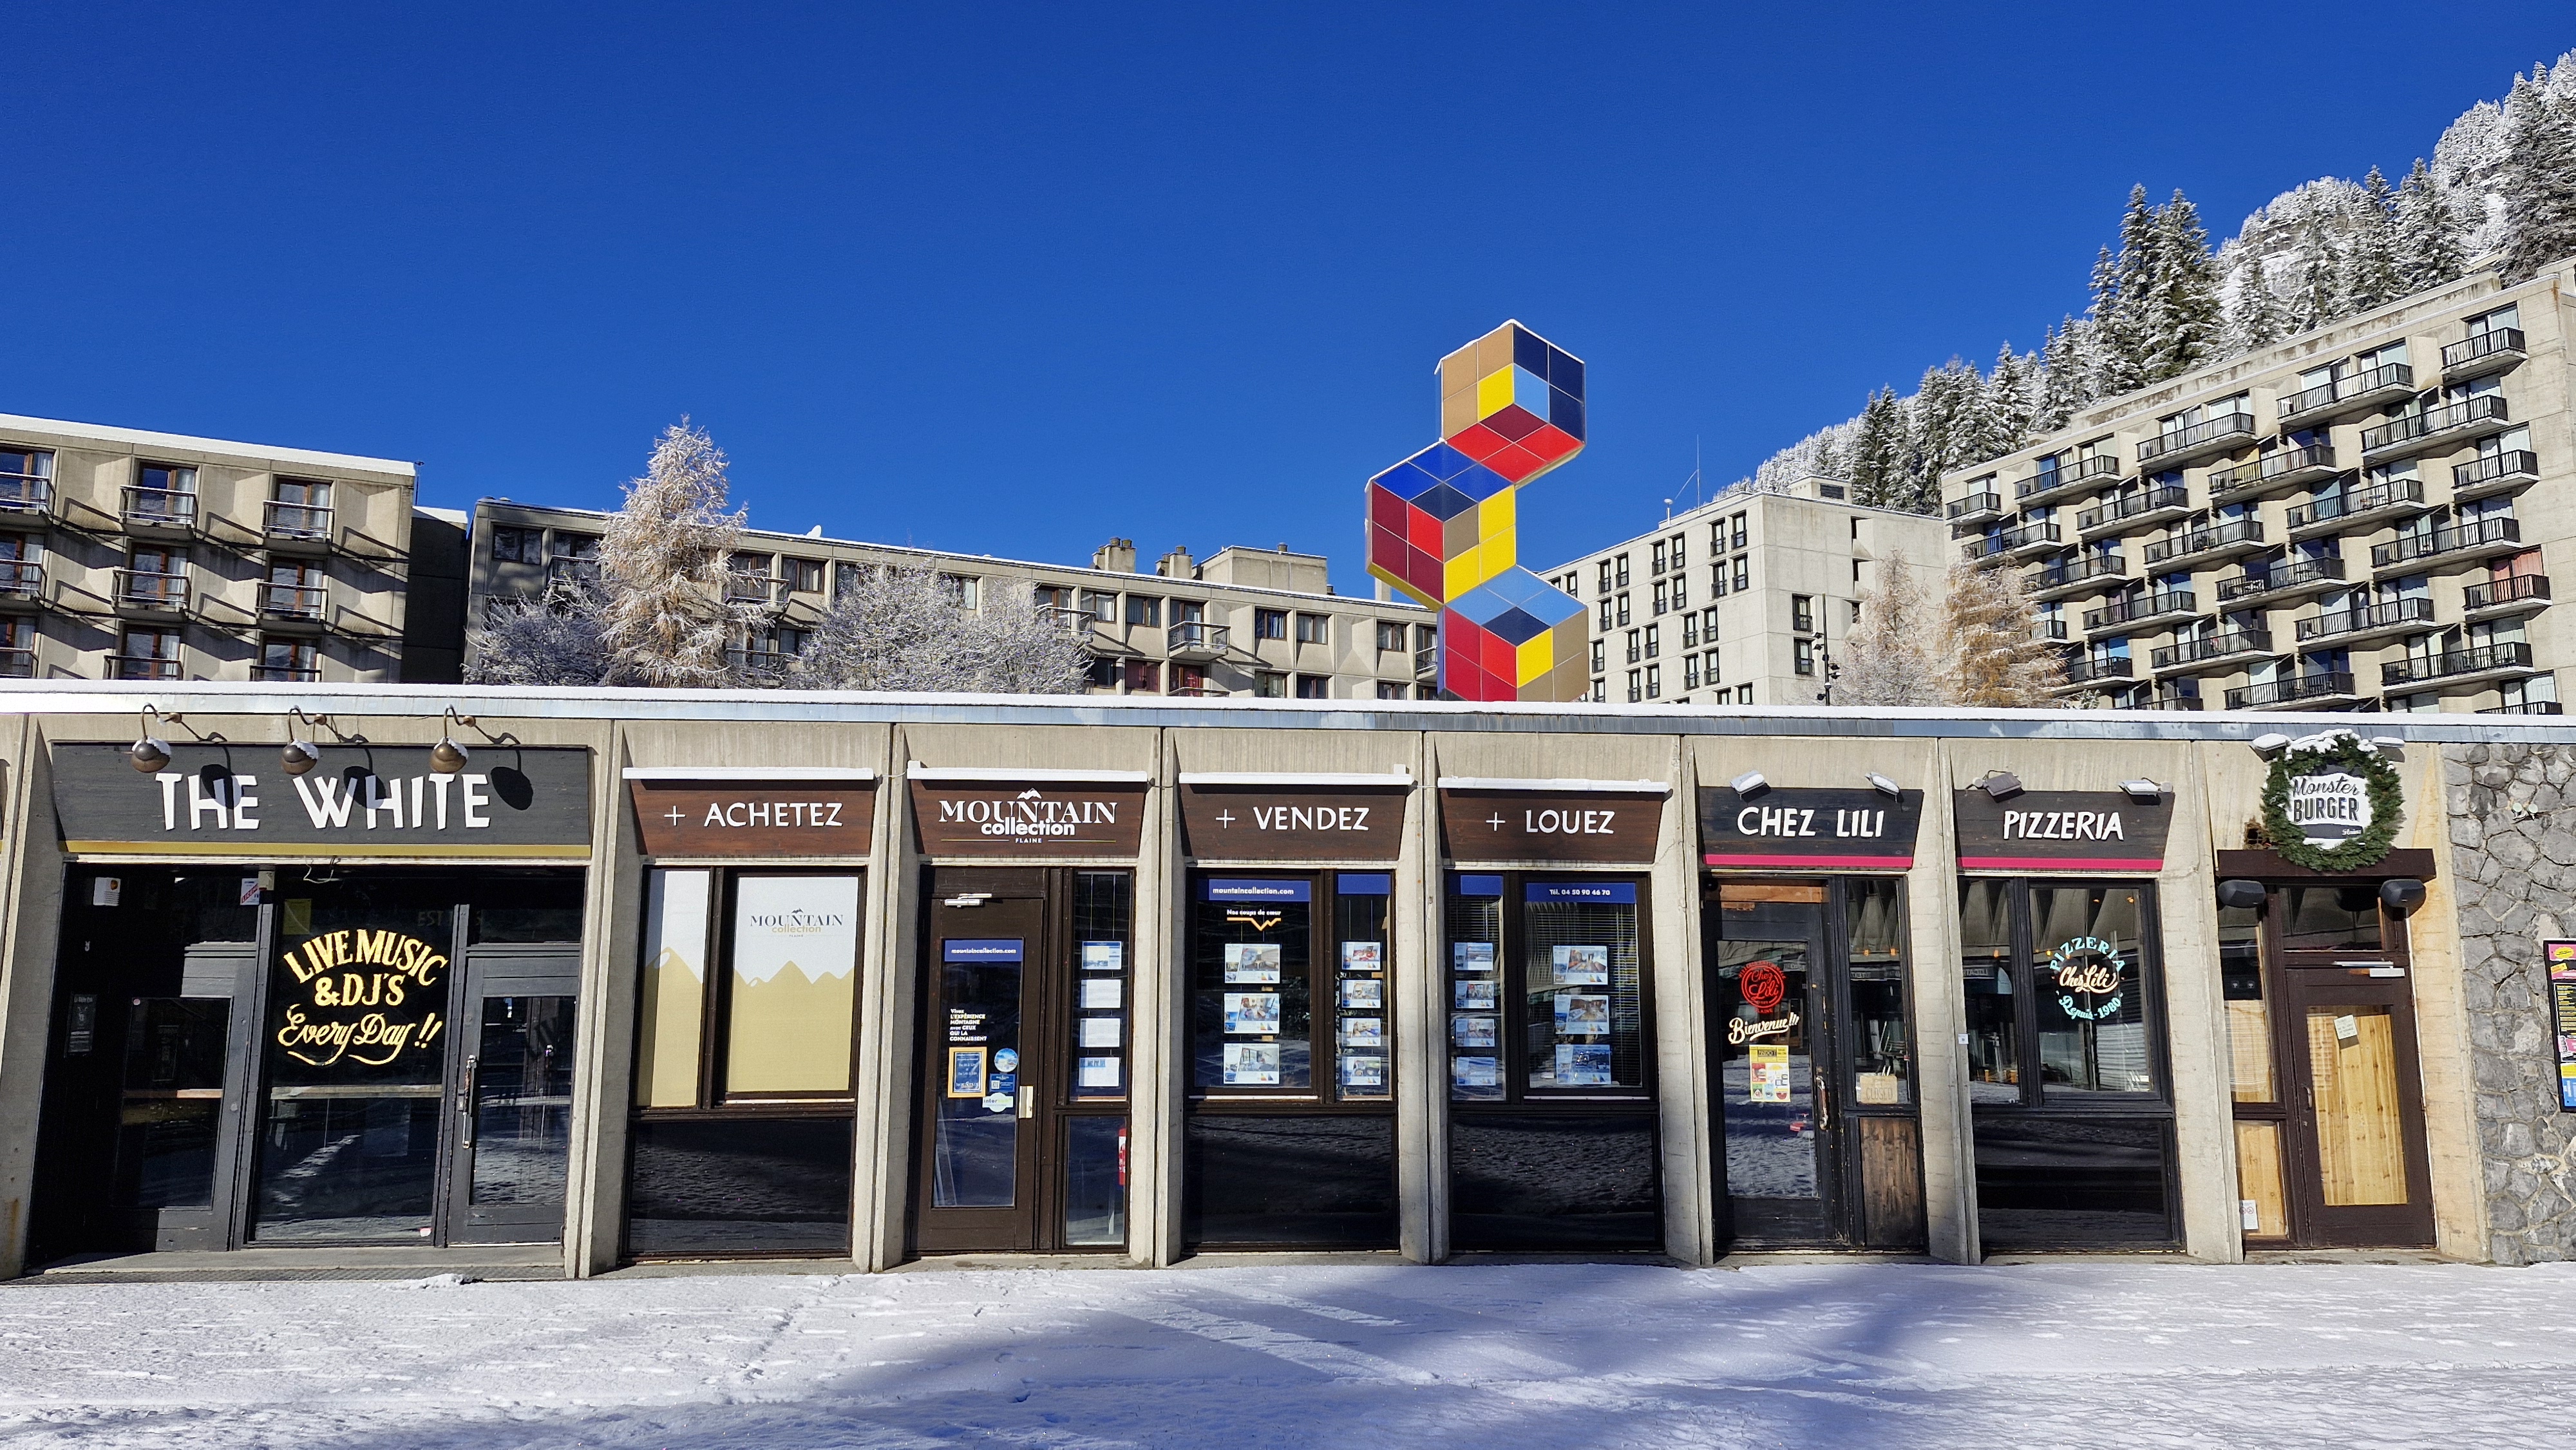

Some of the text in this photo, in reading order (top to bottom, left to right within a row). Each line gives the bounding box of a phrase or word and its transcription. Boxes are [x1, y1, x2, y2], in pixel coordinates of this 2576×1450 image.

[2293, 775, 2360, 797] Monster
[155, 773, 490, 831] THE WHITE
[704, 802, 843, 827] ACHETEZ
[938, 800, 1117, 824] MOUNTAIN
[2293, 797, 2359, 823] BURGER
[981, 816, 1075, 836] collection
[1253, 807, 1370, 831] VENDEZ
[1526, 809, 1615, 834] LOUEZ
[1737, 806, 1884, 837] CHEZ LILI
[2003, 811, 2124, 841] PIZZERIA
[750, 914, 843, 927] MOUNTAIN
[772, 924, 821, 933] collection
[283, 928, 449, 986] LIVE MUSIC
[2050, 936, 2125, 972] PIZZERIA
[1751, 967, 1773, 984] Chez
[2060, 964, 2119, 994] Chez Lili
[1748, 979, 1779, 1001] Lili
[278, 1003, 359, 1066] Every
[348, 1012, 417, 1066] Day
[1866, 1087, 1893, 1100] CLOSED
